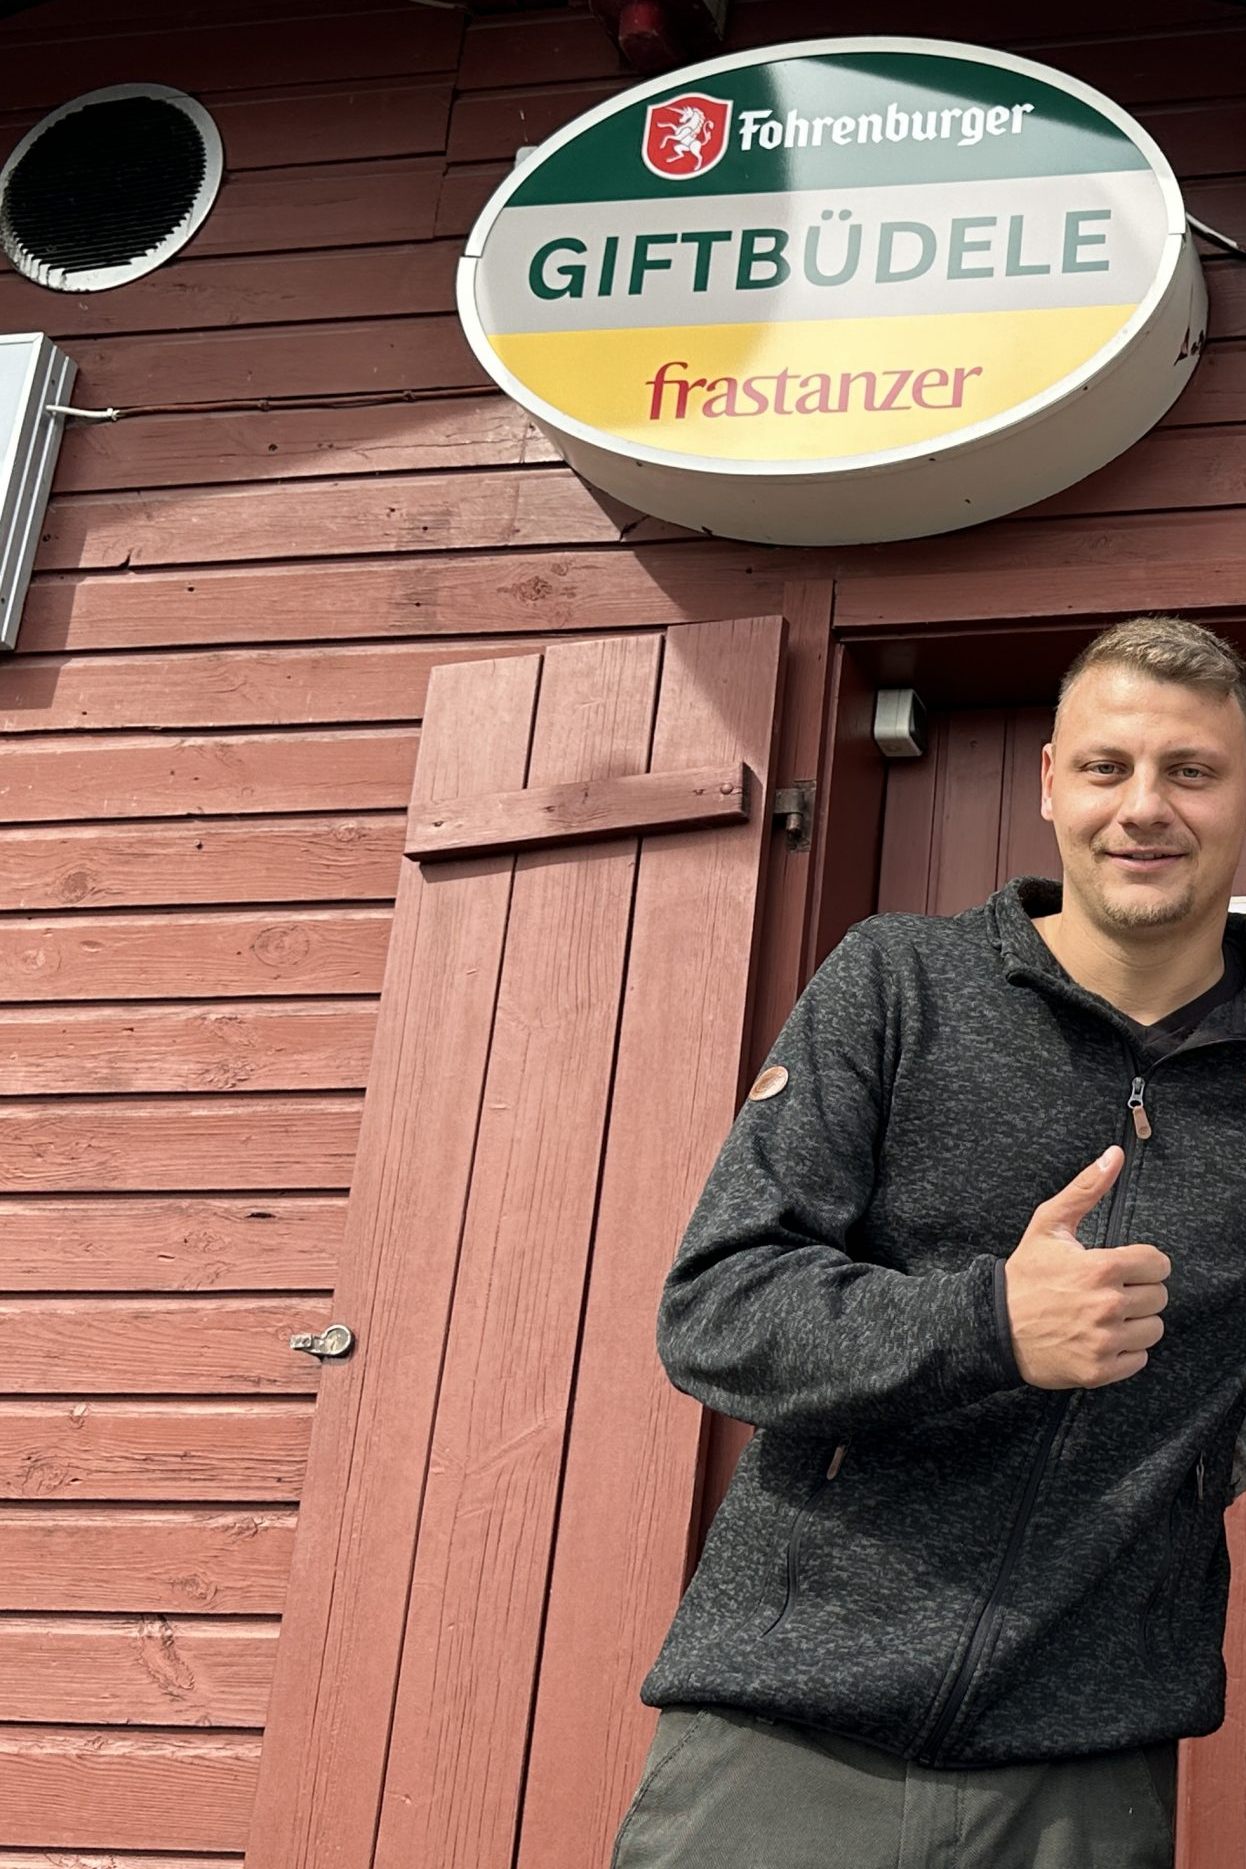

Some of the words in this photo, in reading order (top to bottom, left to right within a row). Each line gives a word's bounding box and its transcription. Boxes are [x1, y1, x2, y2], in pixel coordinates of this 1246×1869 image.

[739, 102, 1035, 151] Fohrenburger
[528, 208, 1112, 301] GIFTBÜDELE
[646, 361, 982, 421] frastanzer
